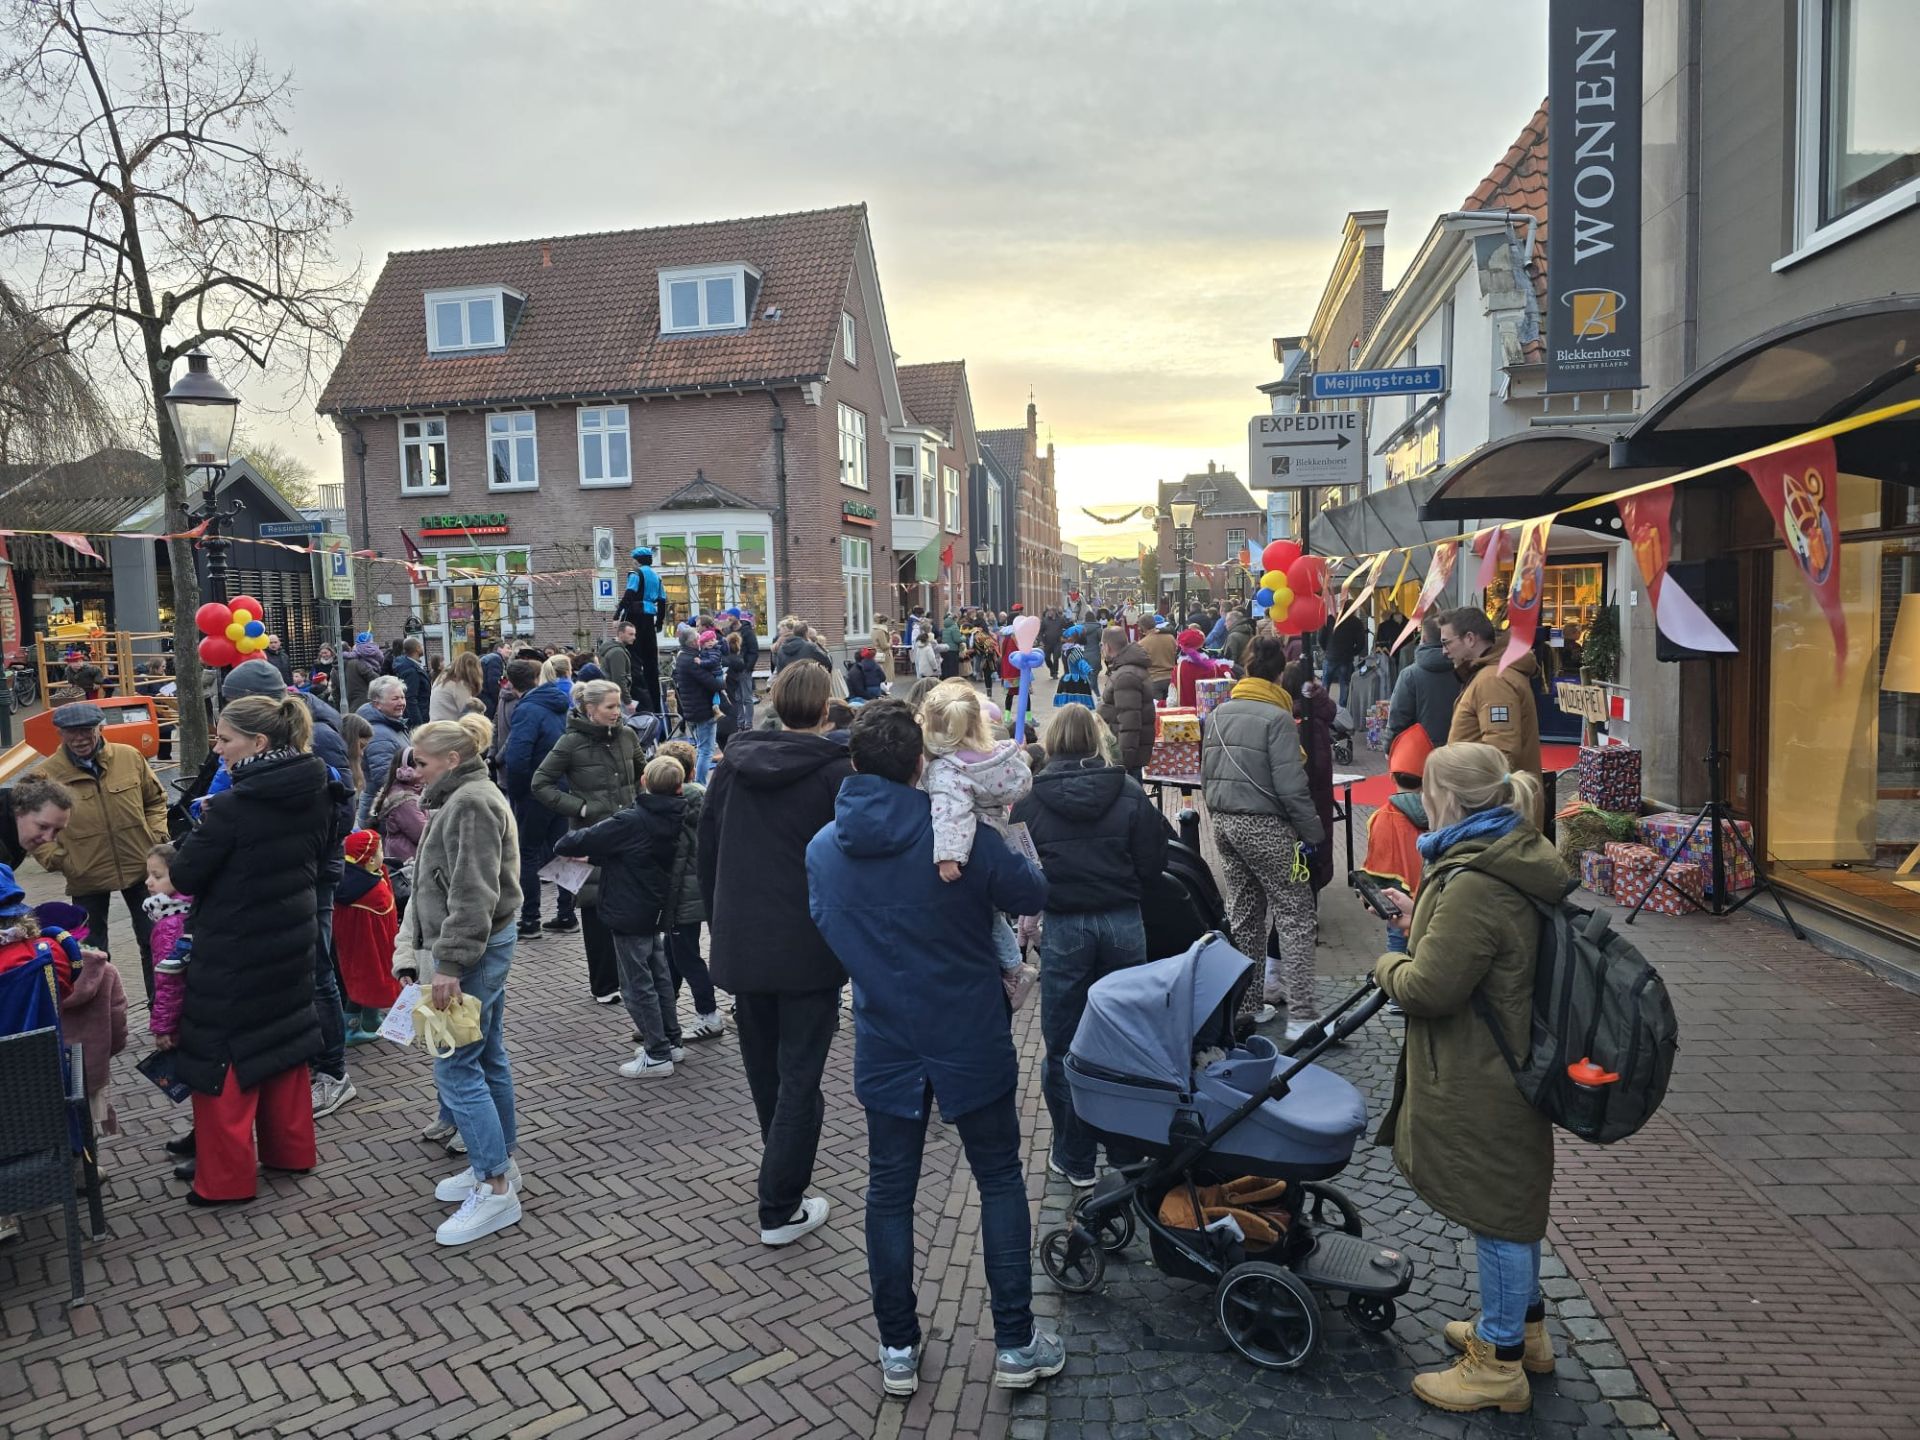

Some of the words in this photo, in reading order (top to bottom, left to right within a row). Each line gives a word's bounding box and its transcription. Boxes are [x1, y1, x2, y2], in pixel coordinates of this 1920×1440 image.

[1573, 26, 1617, 265] WONEN
[1556, 347, 1631, 361] Blekkenhorst
[1325, 371, 1431, 391] Meijlingstraat
[1259, 414, 1356, 433] EXPEDITIE
[602, 581, 610, 595] P
